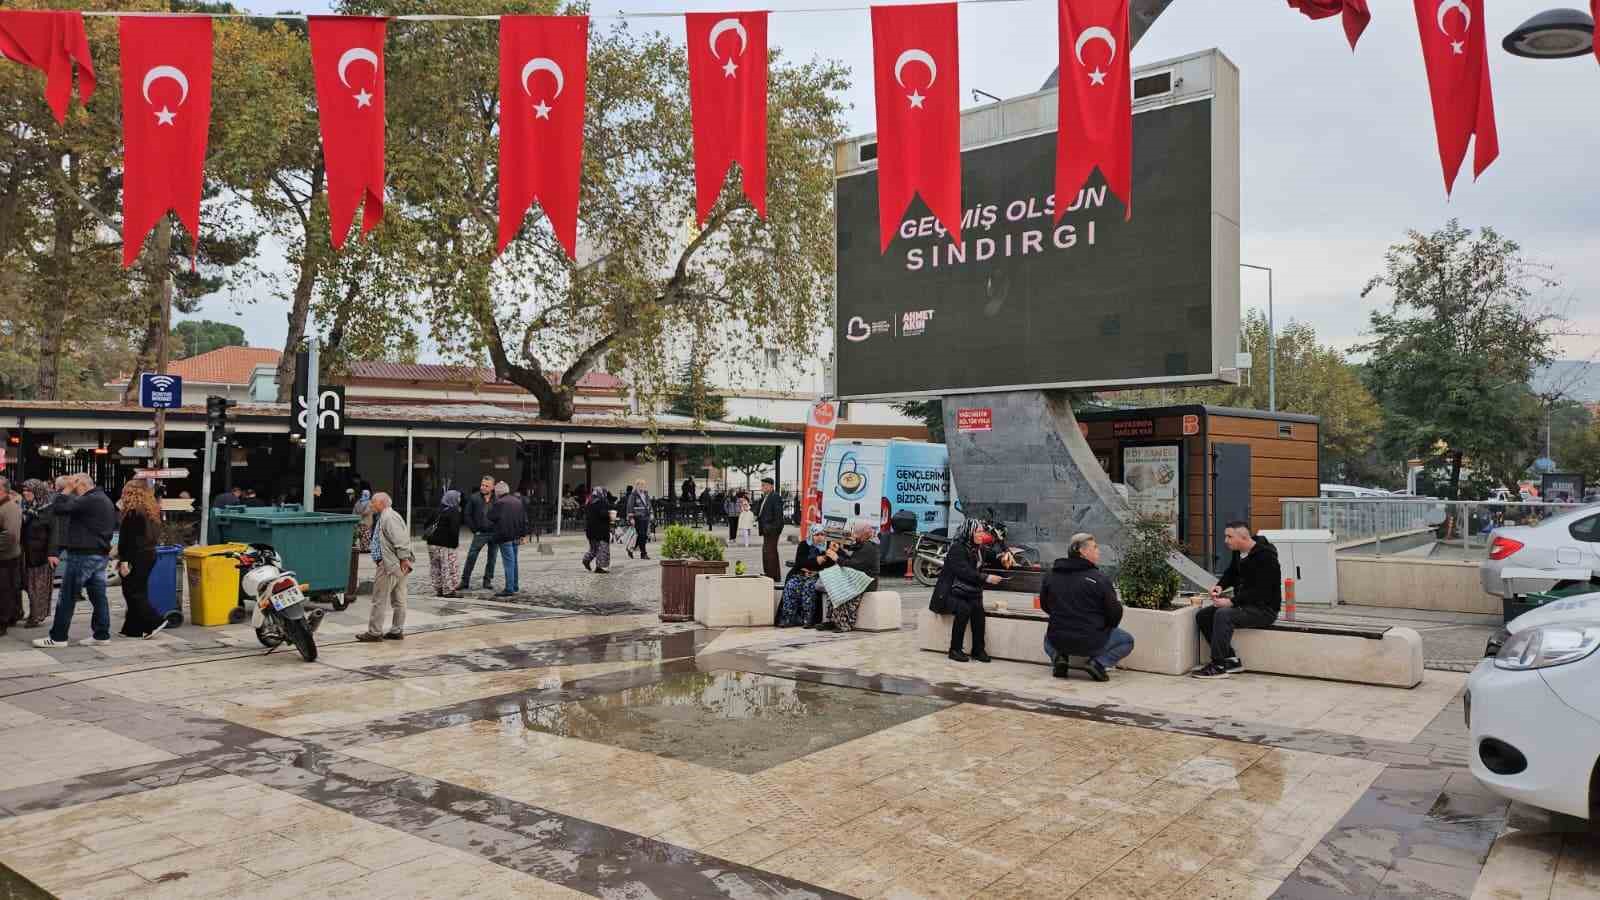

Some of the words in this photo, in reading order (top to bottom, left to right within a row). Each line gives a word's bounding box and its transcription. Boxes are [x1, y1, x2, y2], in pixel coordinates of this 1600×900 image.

[906, 221, 1095, 270] SINDIRGI
[896, 480, 940, 492] GÜNAYDIN
[896, 491, 928, 504] BİZDEN.
